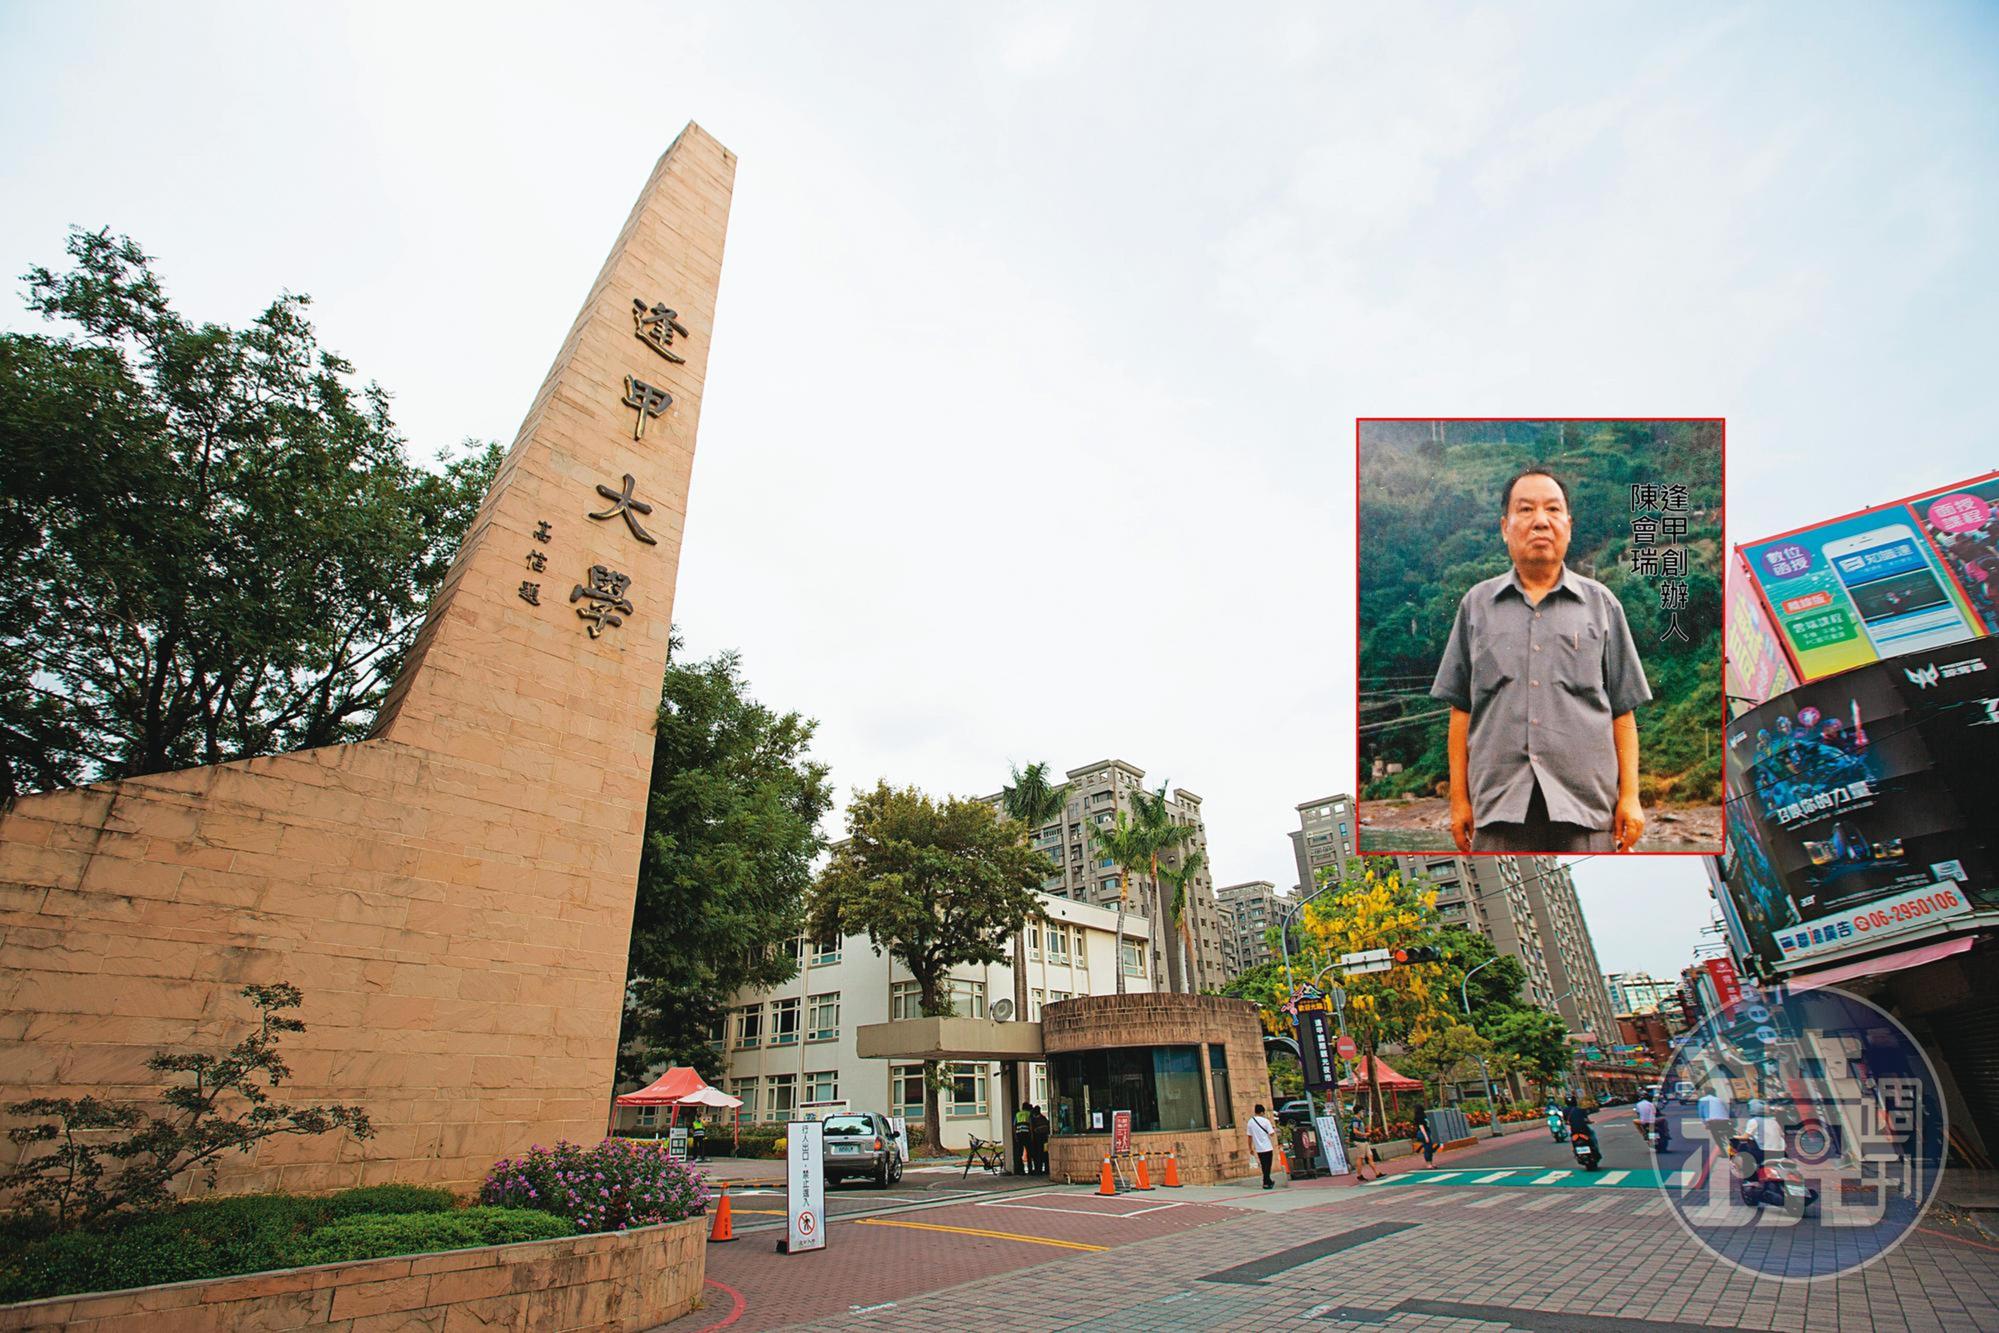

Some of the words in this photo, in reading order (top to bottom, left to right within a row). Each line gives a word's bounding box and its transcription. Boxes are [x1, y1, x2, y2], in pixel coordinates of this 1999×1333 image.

[570, 298, 689, 639] 逢甲大學
[1868, 890, 1960, 928] 06-2950106
